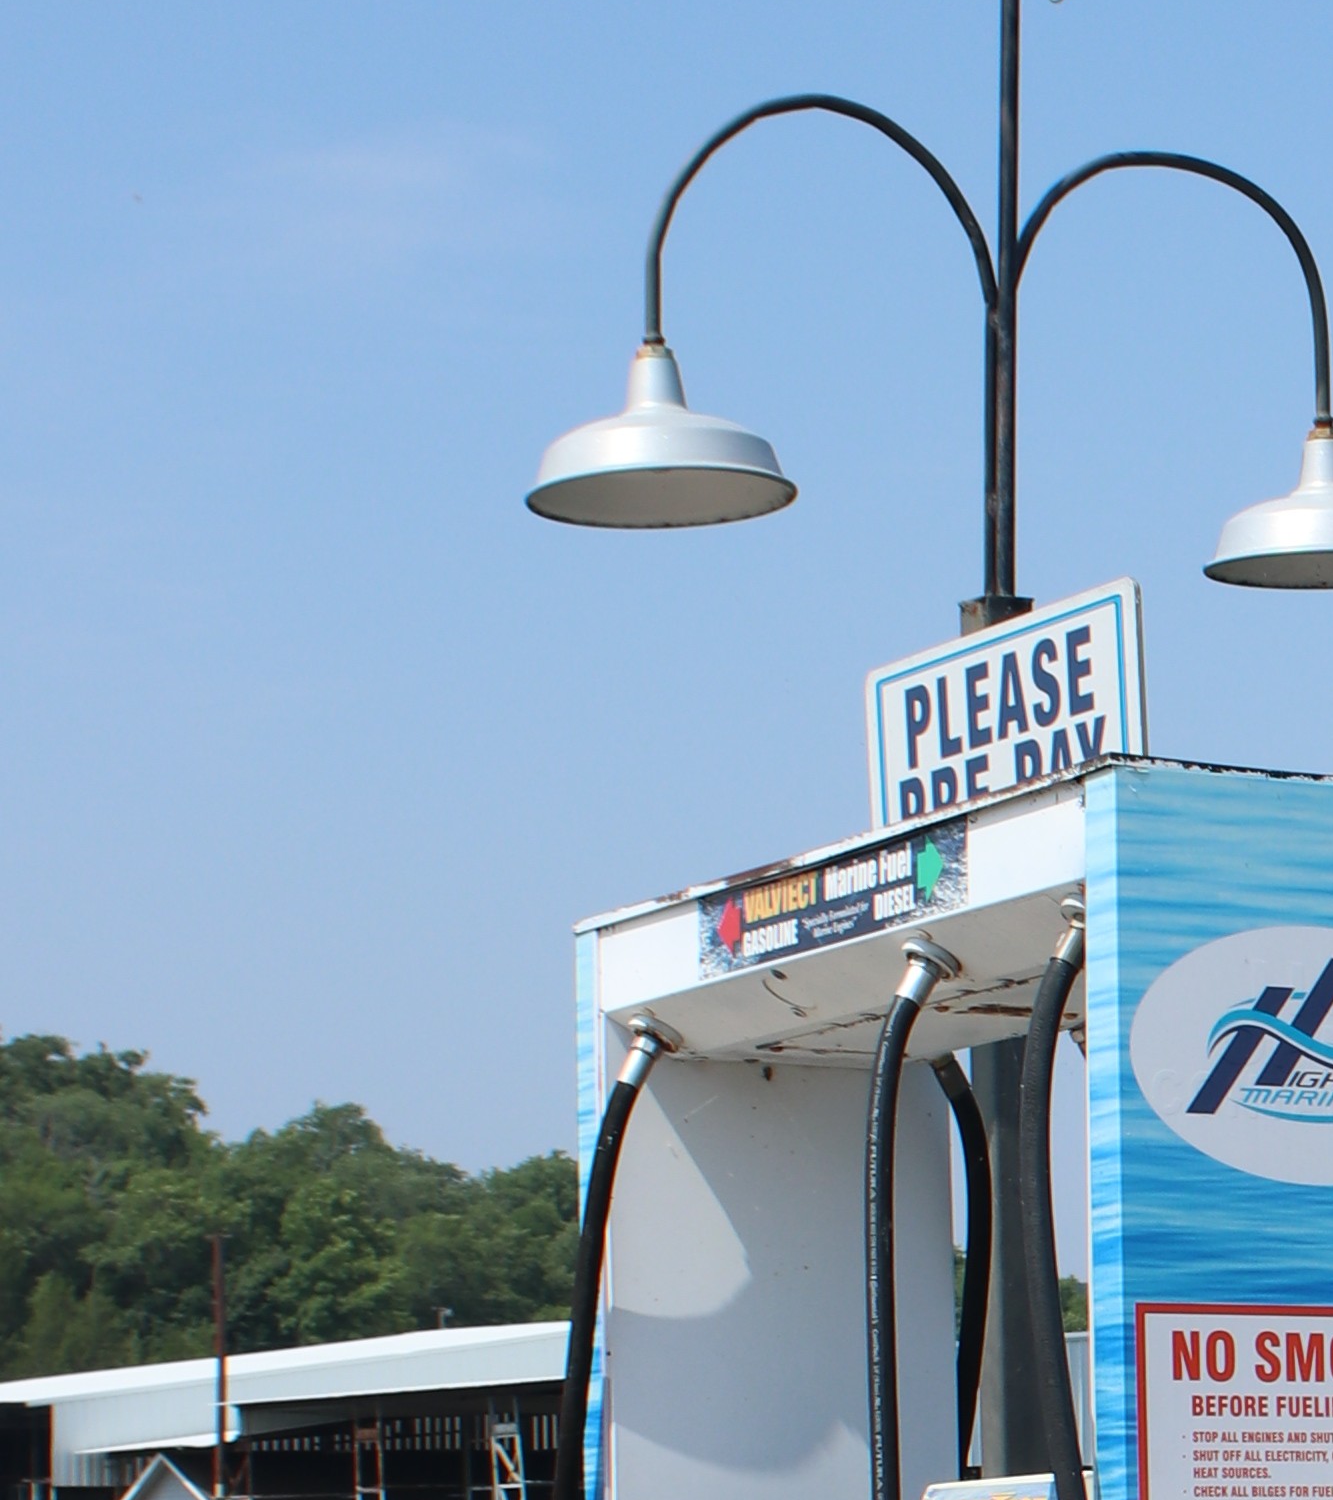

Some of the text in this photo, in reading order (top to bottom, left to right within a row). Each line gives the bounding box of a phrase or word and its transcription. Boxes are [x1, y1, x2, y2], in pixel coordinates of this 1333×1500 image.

[904, 625, 1094, 769] PLEASE
[823, 858, 878, 901] Marine
[878, 841, 912, 885] Fuel
[873, 883, 915, 921] DIESEL
[742, 919, 799, 957] GASOLINE
[1171, 1329, 1236, 1382] NO
[1192, 1394, 1269, 1417] BEFORE
[1192, 1431, 1218, 1443] STOP
[1220, 1431, 1239, 1442] ALL
[1241, 1431, 1284, 1443] ENGINES
[1286, 1432, 1307, 1443] AND
[1193, 1449, 1219, 1461] SHUT
[1222, 1450, 1241, 1461] OFF
[1244, 1450, 1262, 1461] ALL
[1265, 1450, 1329, 1462] ELECTRICITY,
[1193, 1466, 1272, 1479] HEAT SOURCES.
[1193, 1485, 1228, 1497] CHECK
[1230, 1486, 1248, 1497] ALL
[1251, 1485, 1286, 1497] BILGES
[1289, 1486, 1309, 1497] FOR
